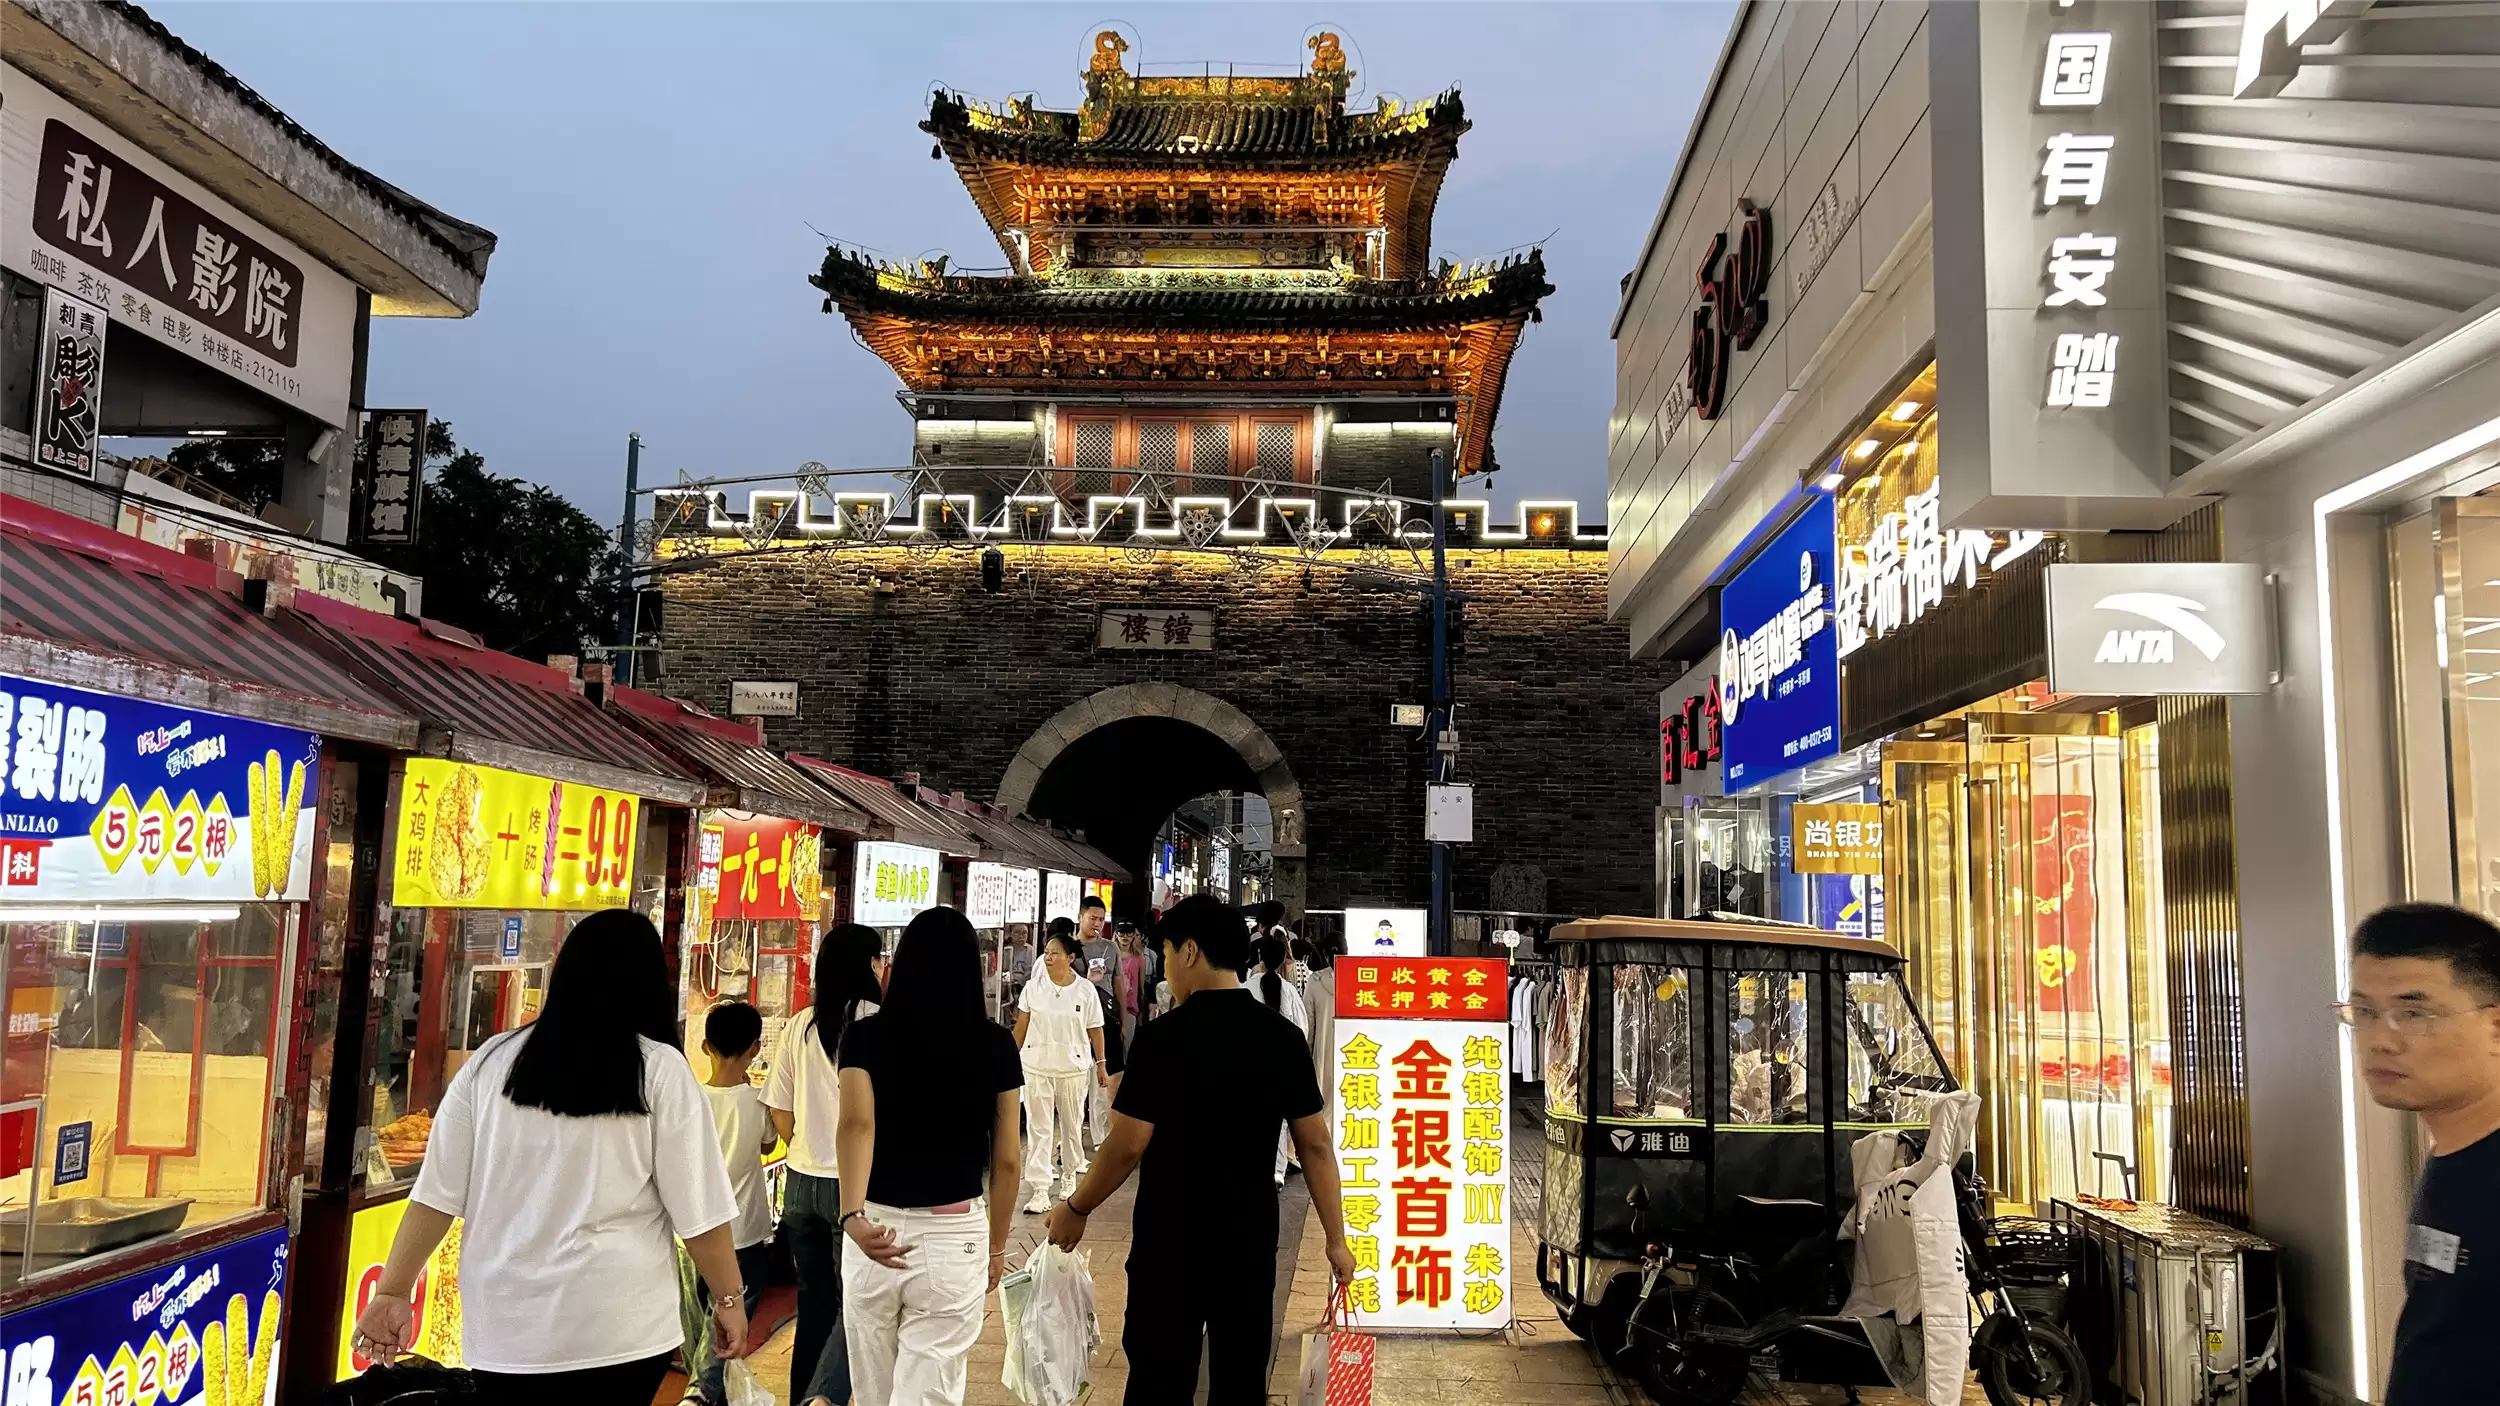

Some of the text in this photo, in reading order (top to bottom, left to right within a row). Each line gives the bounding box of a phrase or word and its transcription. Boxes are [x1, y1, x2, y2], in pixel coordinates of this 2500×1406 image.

[2040, 0, 2119, 406] 国有安踏
[57, 149, 291, 350] 私人影院
[31, 249, 67, 282] 咖啡
[77, 271, 111, 306] 茶饮
[121, 292, 152, 327] 零食
[163, 315, 192, 345] 电影
[59, 303, 95, 336] 刺青
[371, 416, 414, 530] 快捷旅馆
[1836, 475, 2043, 659] 金瑞福
[2094, 630, 2173, 663] ANTA
[106, 811, 228, 858] 5元2根
[406, 776, 429, 876] 大鸡排
[524, 808, 542, 870] 烤肠
[585, 795, 631, 887] 9.9
[1440, 796, 1463, 804] 公安
[723, 831, 793, 907] 一元一串
[1355, 990, 1488, 1010] 抵押黄金
[1357, 967, 1488, 986] 回收黄金
[1340, 1032, 1382, 1314] 金银加工零损耗
[1391, 1039, 1453, 1310] 金银首饰
[1462, 1035, 1506, 1315] 纯银配饰 DIY 朱砂
[1641, 1132, 1690, 1152] 雅迪
[0, 1336, 54, 1406] 肠
[77, 1343, 188, 1406] 5元2根
